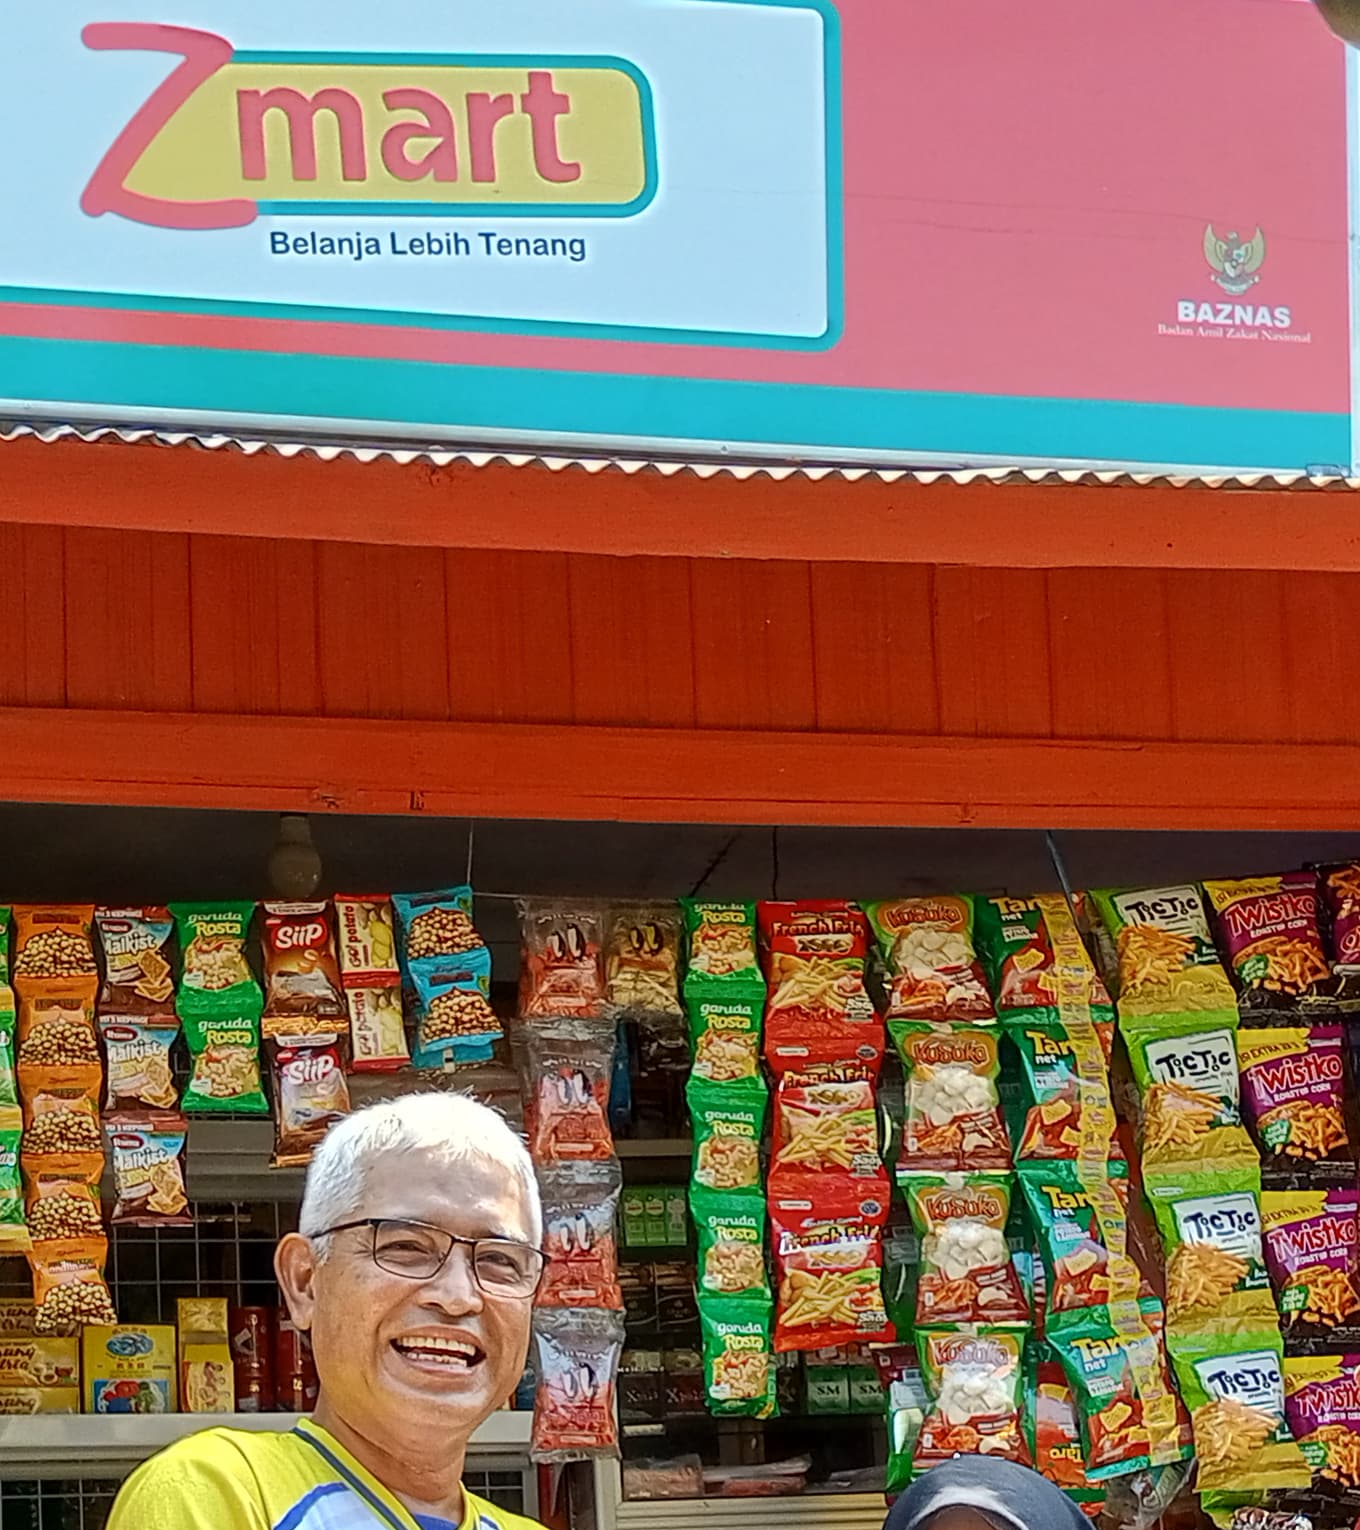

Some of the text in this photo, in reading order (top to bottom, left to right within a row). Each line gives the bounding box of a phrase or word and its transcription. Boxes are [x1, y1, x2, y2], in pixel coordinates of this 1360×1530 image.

[81, 22, 581, 230] Zmart
[269, 231, 586, 261] Belanja Lebih Tenang
[1177, 300, 1291, 328] BAZNAS
[1158, 324, 1194, 336] Badan
[772, 920, 830, 938] French
